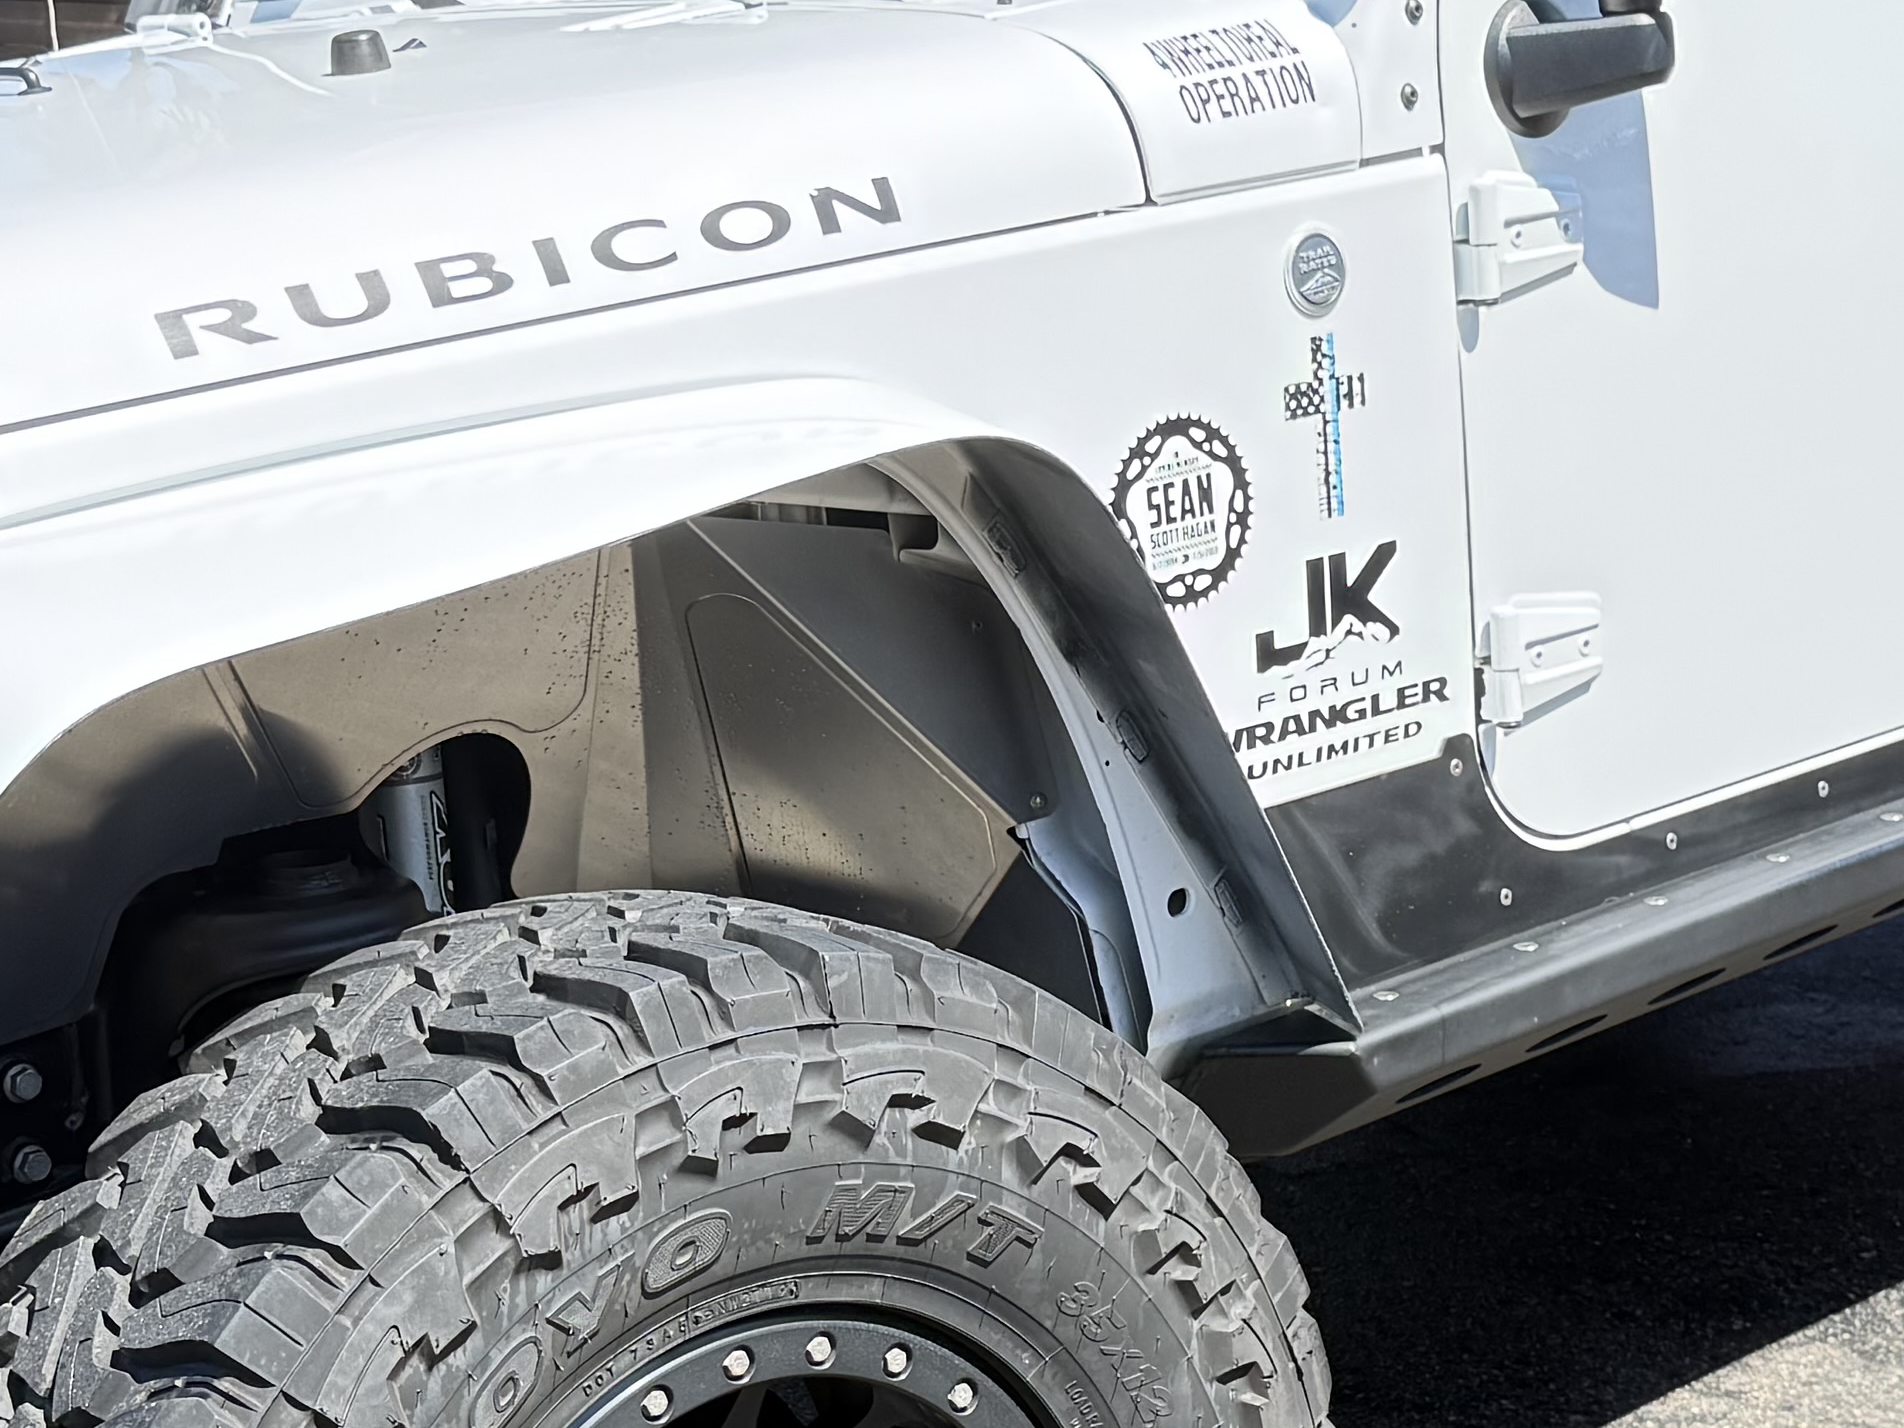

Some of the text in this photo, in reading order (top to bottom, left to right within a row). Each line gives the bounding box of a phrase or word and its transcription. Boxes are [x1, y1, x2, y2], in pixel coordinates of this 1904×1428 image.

[1178, 59, 1316, 124] OPERATION
[152, 176, 902, 360] RUBICON
[1298, 245, 1335, 263] TRAIL
[1146, 472, 1215, 530] SEAN
[1150, 519, 1217, 551] SCOTT HAGAN
[1255, 539, 1401, 674] JK
[1257, 660, 1404, 712] FORUM
[1246, 720, 1424, 781] UNLIMITED
[804, 1179, 1045, 1270] M/T
[1062, 1379, 1095, 1418] LOAD
